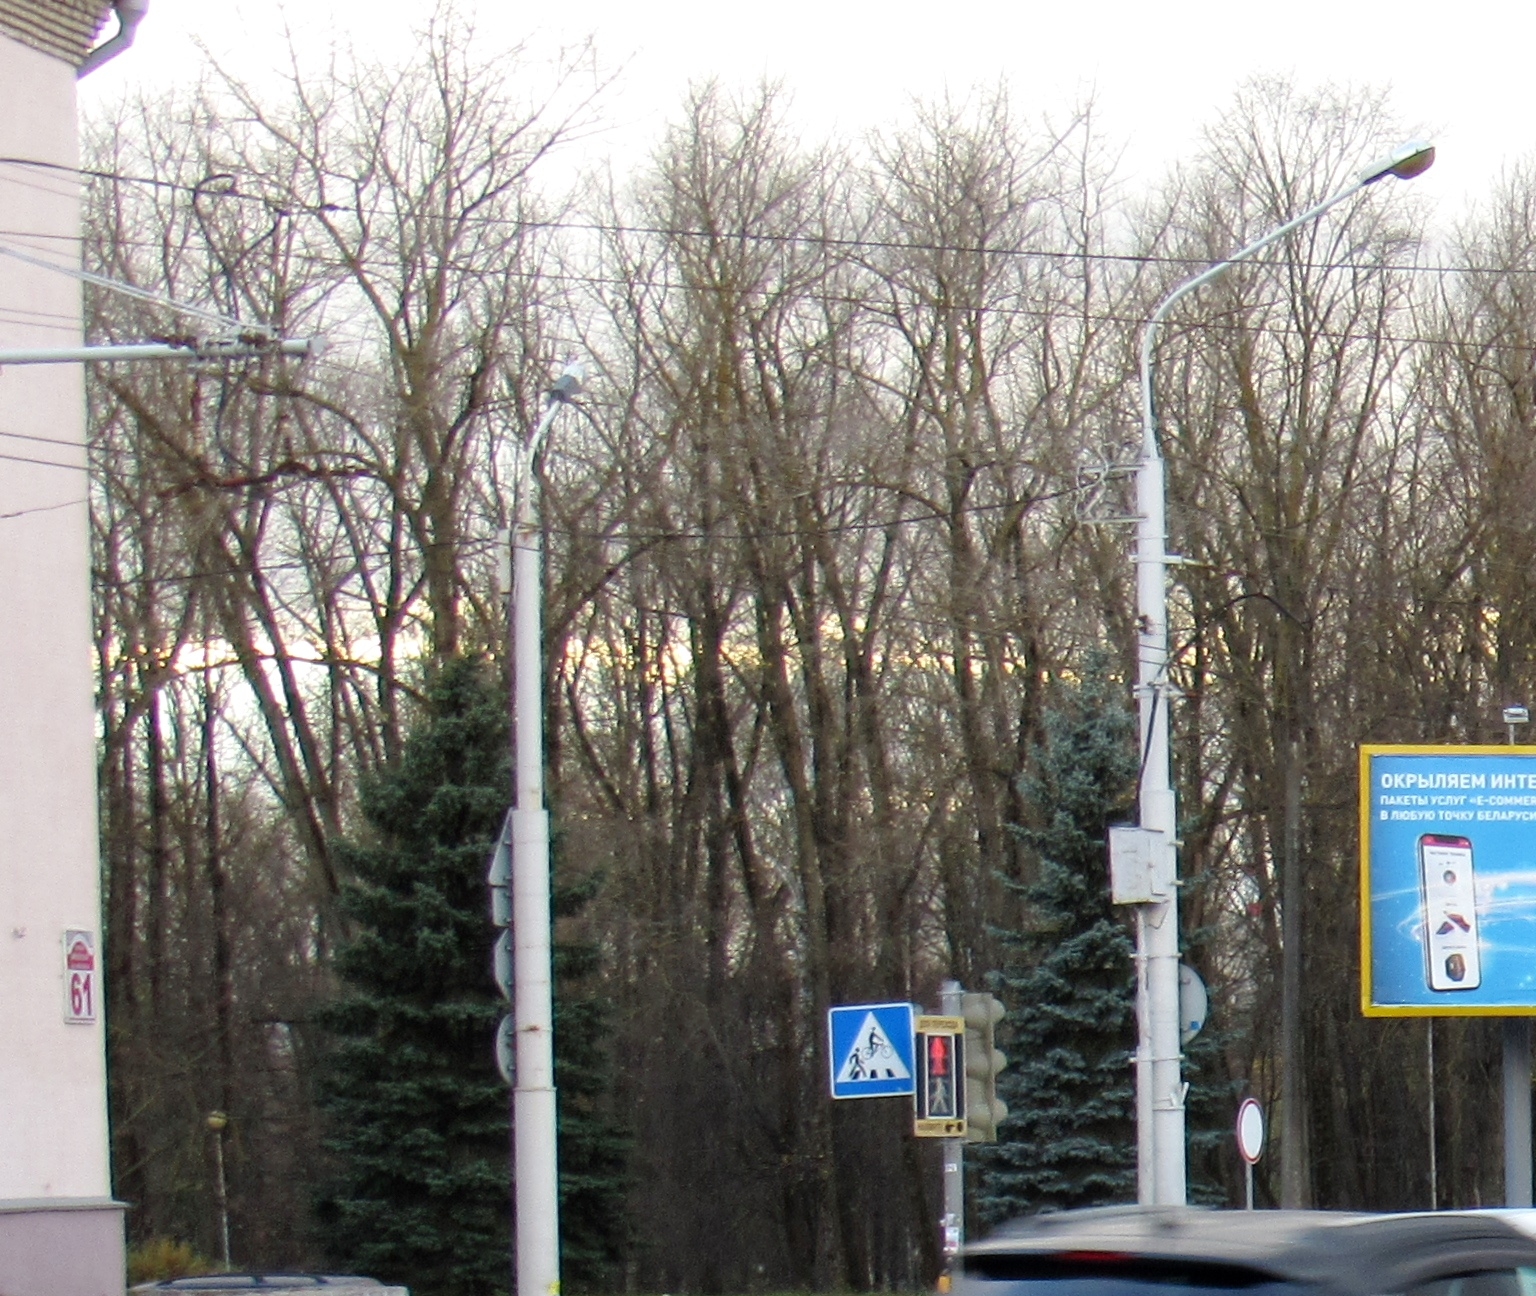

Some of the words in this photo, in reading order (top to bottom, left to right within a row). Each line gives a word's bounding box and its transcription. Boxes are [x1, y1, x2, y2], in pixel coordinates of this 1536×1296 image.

[1380, 773, 1486, 789] ОКРЫЛЯЕМ
[1380, 795, 1428, 806] ПАКЕТЫ
[1431, 795, 1467, 806] УСЛУГ
[1380, 810, 1389, 820] В
[1391, 810, 1436, 821] ЛЮБУЮ
[1438, 810, 1475, 821] ТОЧКУ
[71, 972, 92, 1016] 61
